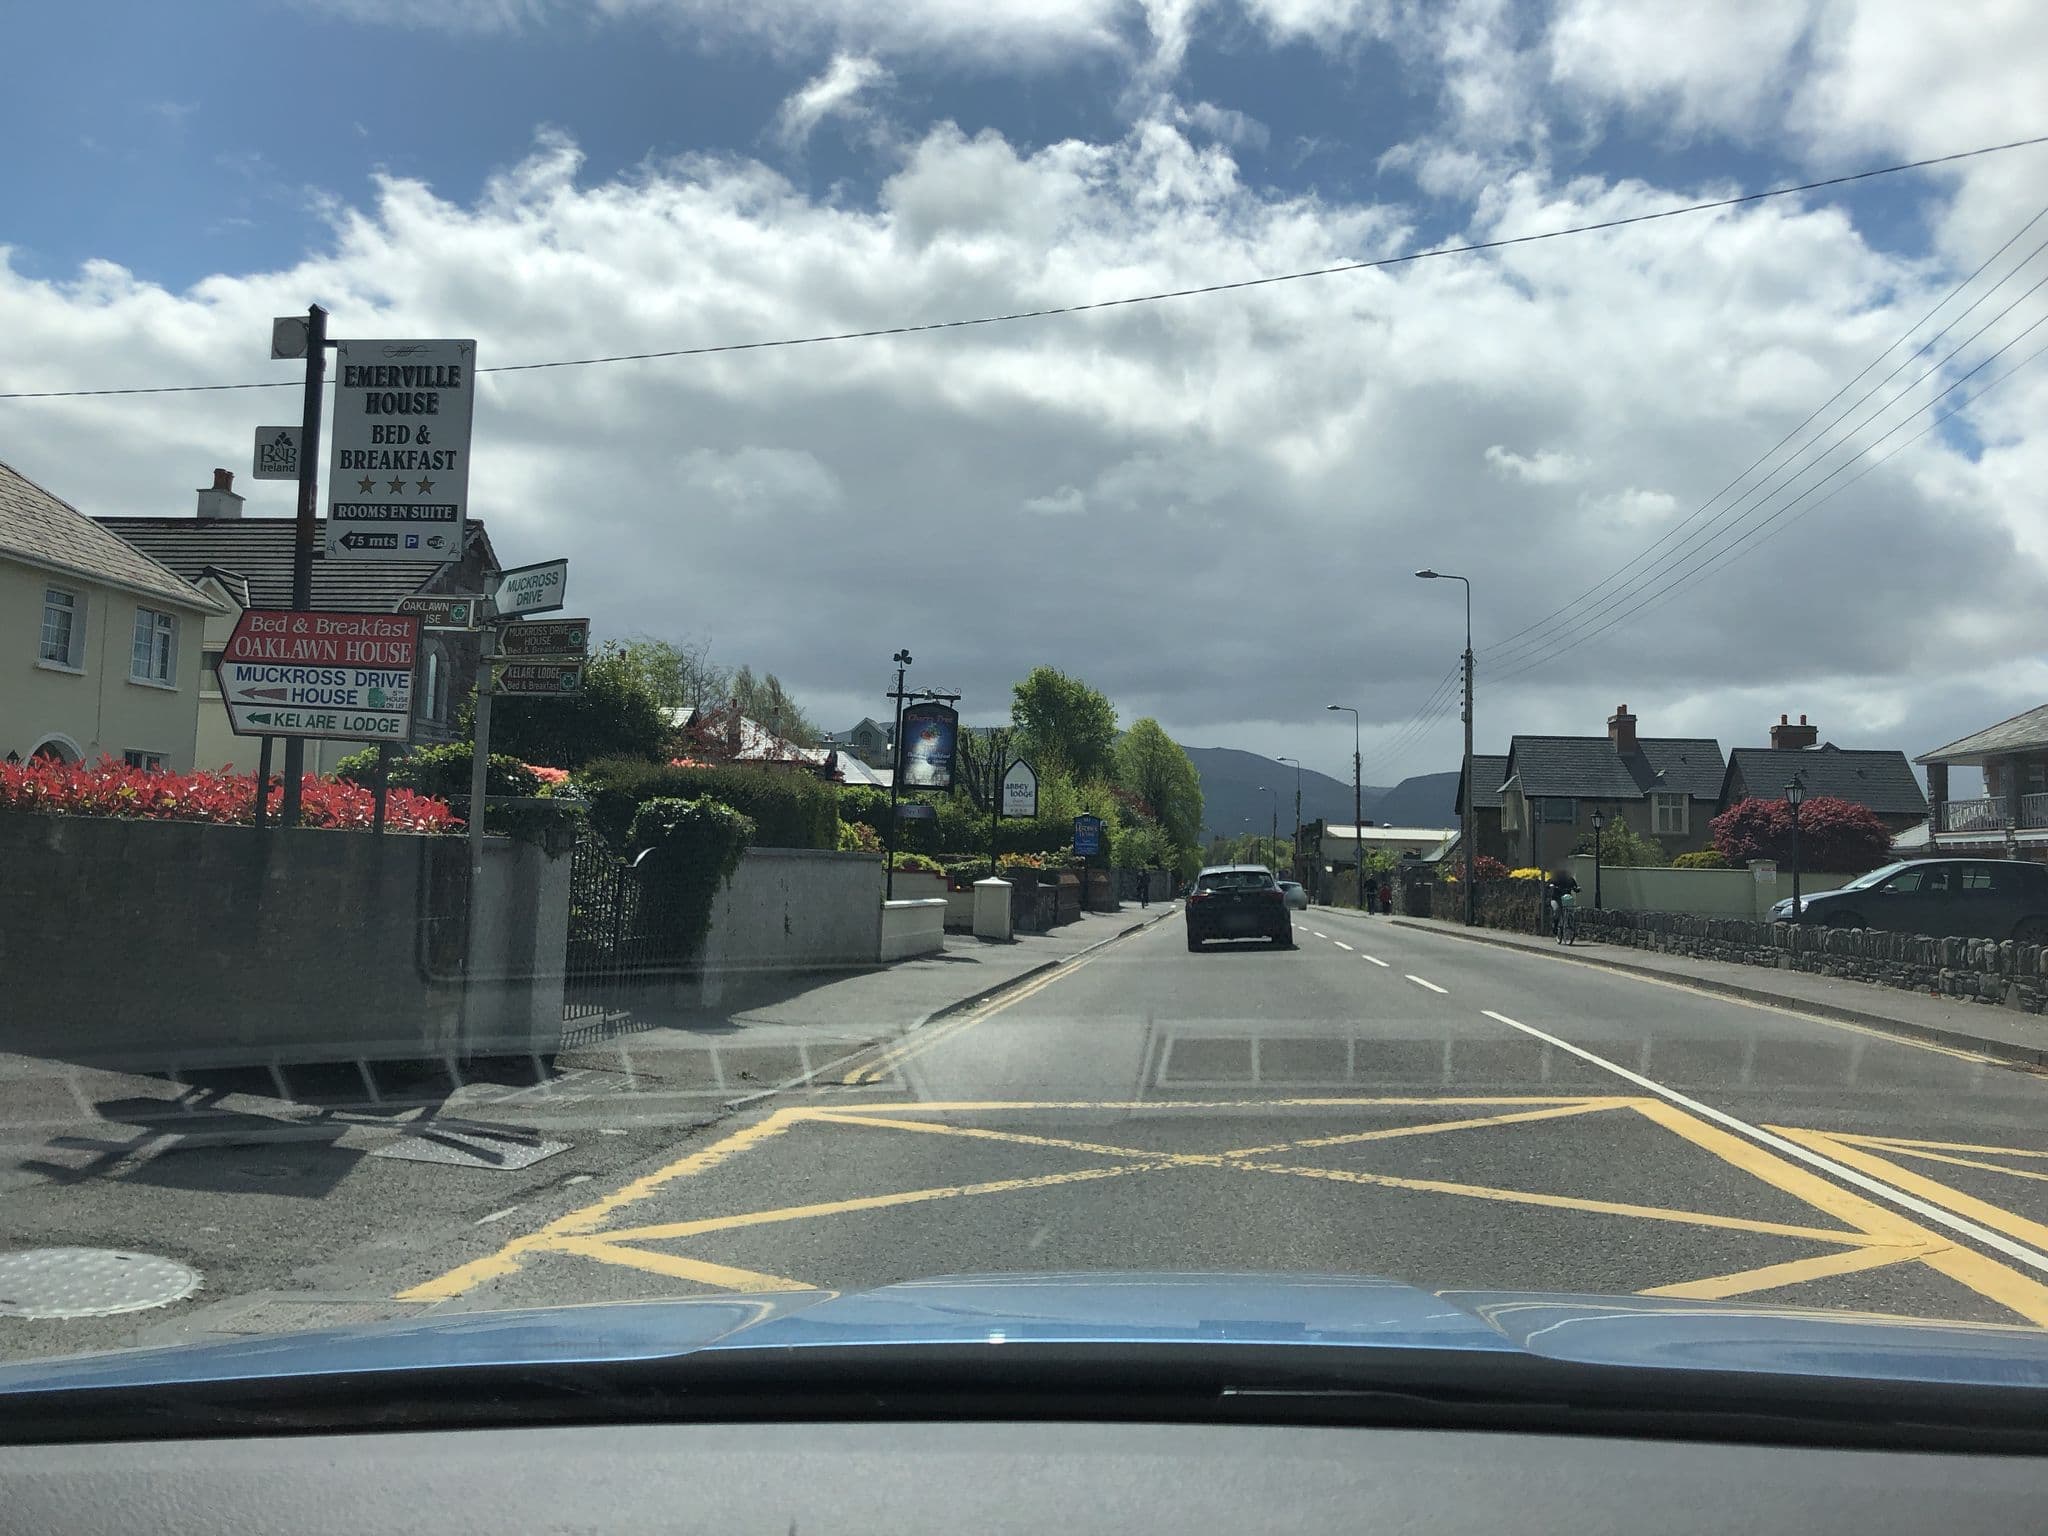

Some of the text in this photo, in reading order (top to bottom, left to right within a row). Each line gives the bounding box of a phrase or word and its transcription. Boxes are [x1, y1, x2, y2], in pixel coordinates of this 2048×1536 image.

[344, 365, 461, 388] EMERVILLE
[365, 392, 440, 415] HOUSE
[371, 424, 432, 445] BED &
[260, 444, 297, 463] B&B
[340, 449, 457, 470] BREAKFAST
[260, 462, 296, 473] Ireland
[338, 505, 452, 519] ROOMS EN SUITE
[349, 536, 365, 546] 75
[370, 536, 397, 547] mts
[506, 571, 559, 593] MUCKROSS
[403, 600, 450, 612] OAKLAWN
[516, 589, 544, 607] DRIVE
[250, 615, 410, 638] Bed & Breakfast
[509, 625, 569, 637] MUCKROSS DRIVE
[235, 636, 412, 664] OAKLAWN HOUSE
[524, 636, 552, 646] HOUSE
[235, 665, 410, 689] MUCKROSS DRIVE
[508, 666, 561, 679] KELARE LODGE
[507, 680, 520, 690] Bed
[291, 687, 358, 706] HOUSE
[274, 711, 401, 733] KELARE LODGE
